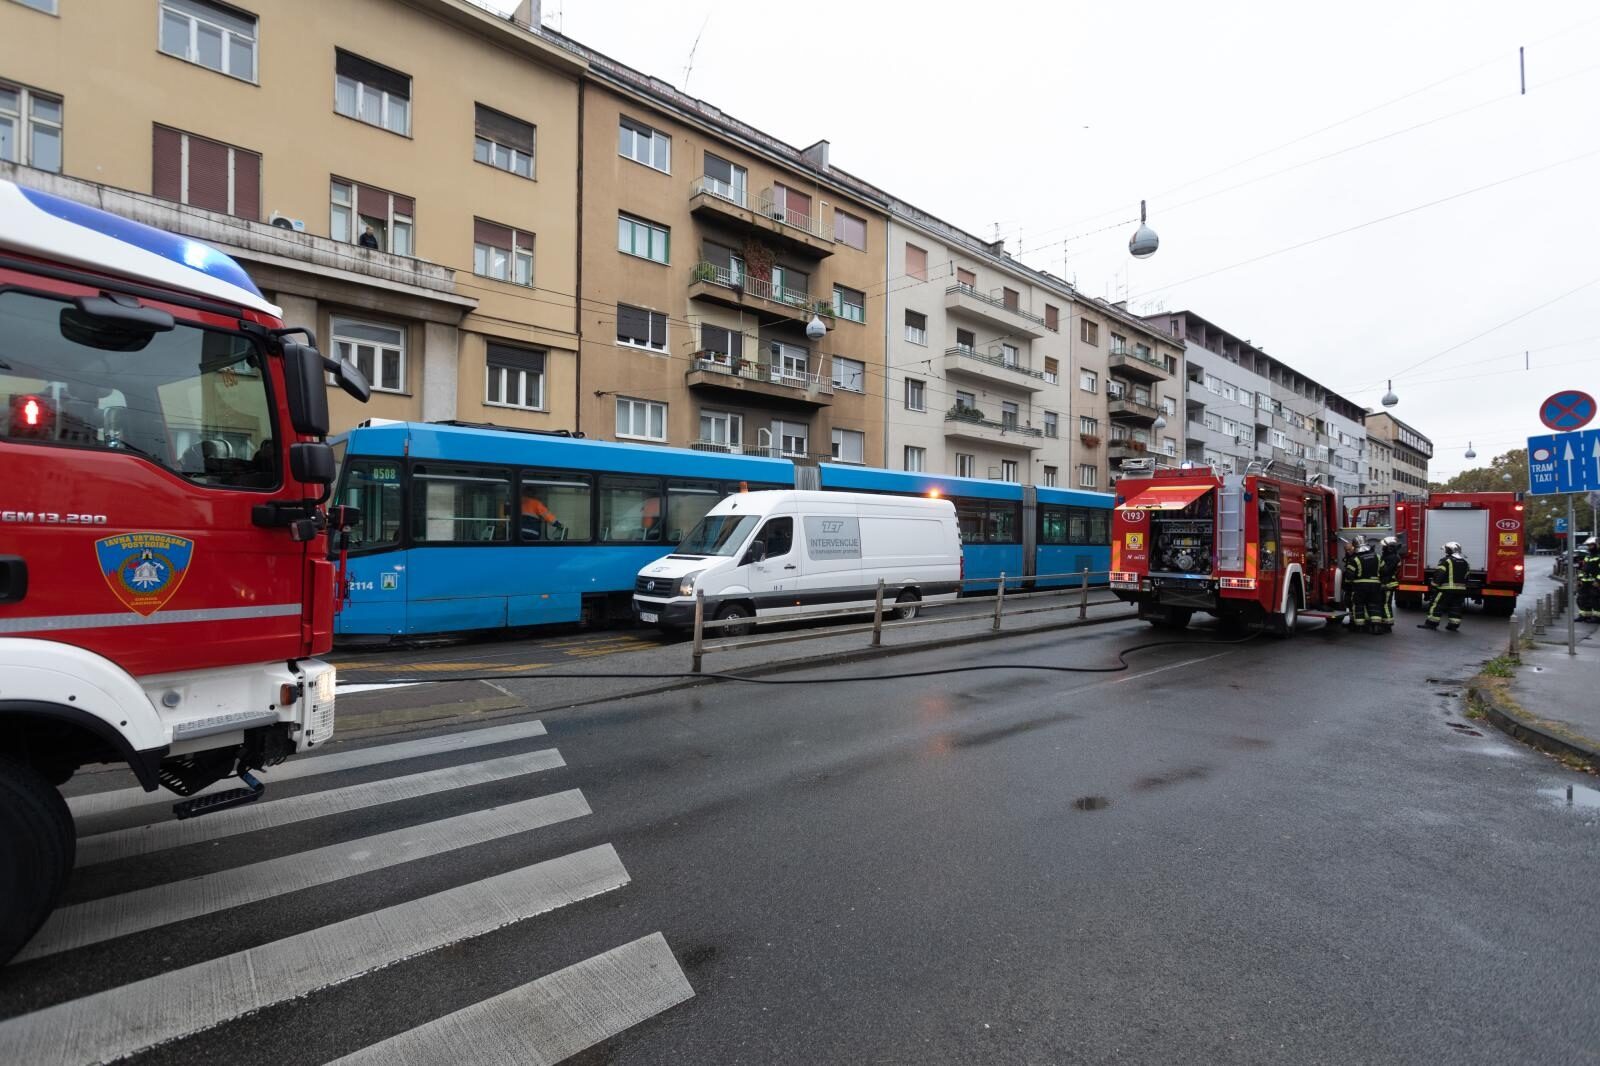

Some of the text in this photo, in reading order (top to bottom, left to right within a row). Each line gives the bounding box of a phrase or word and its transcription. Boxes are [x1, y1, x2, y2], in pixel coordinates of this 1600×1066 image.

[1531, 463, 1554, 473] TRAM
[373, 468, 396, 480] 0508
[1534, 473, 1552, 483] TAXI
[0, 511, 107, 524] GM 13.290
[1127, 512, 1141, 521] 193
[1501, 521, 1516, 529] 193
[349, 581, 374, 591] 2114
